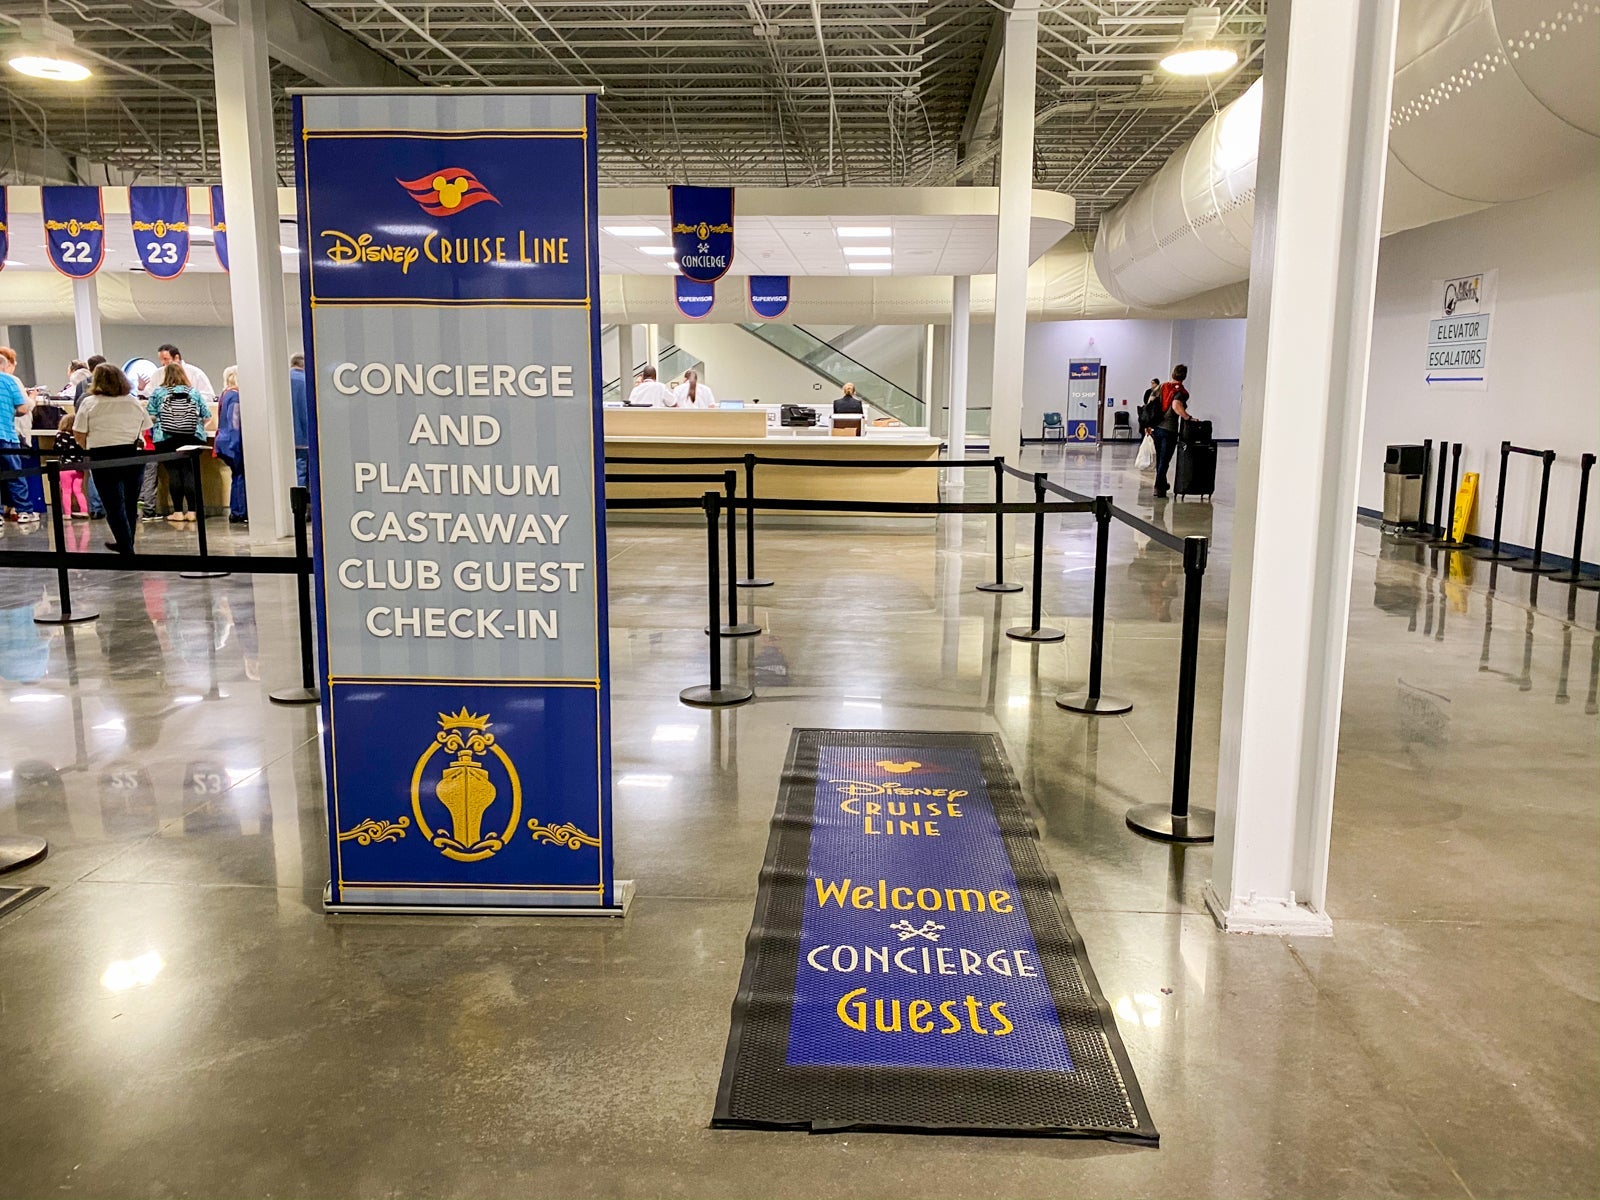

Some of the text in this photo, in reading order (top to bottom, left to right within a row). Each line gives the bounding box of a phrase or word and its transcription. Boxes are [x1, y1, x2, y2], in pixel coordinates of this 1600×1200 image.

[60, 241, 93, 263] 22
[146, 242, 178, 264] 23
[681, 255, 726, 268] CONCIERGE
[1437, 321, 1480, 340] ELEVATOR
[1429, 349, 1481, 367] ESCALATORS
[332, 362, 574, 398] CONCIERGE
[408, 414, 501, 446] AND
[354, 462, 561, 496] PLATINUM
[350, 510, 569, 544] CASTAWAY
[338, 558, 585, 592] CLUB GUEST
[365, 606, 558, 639] CHECK-IN
[814, 877, 1013, 914] Welcome
[806, 944, 1038, 978] CONCIERGE
[836, 987, 1014, 1036] Guests
